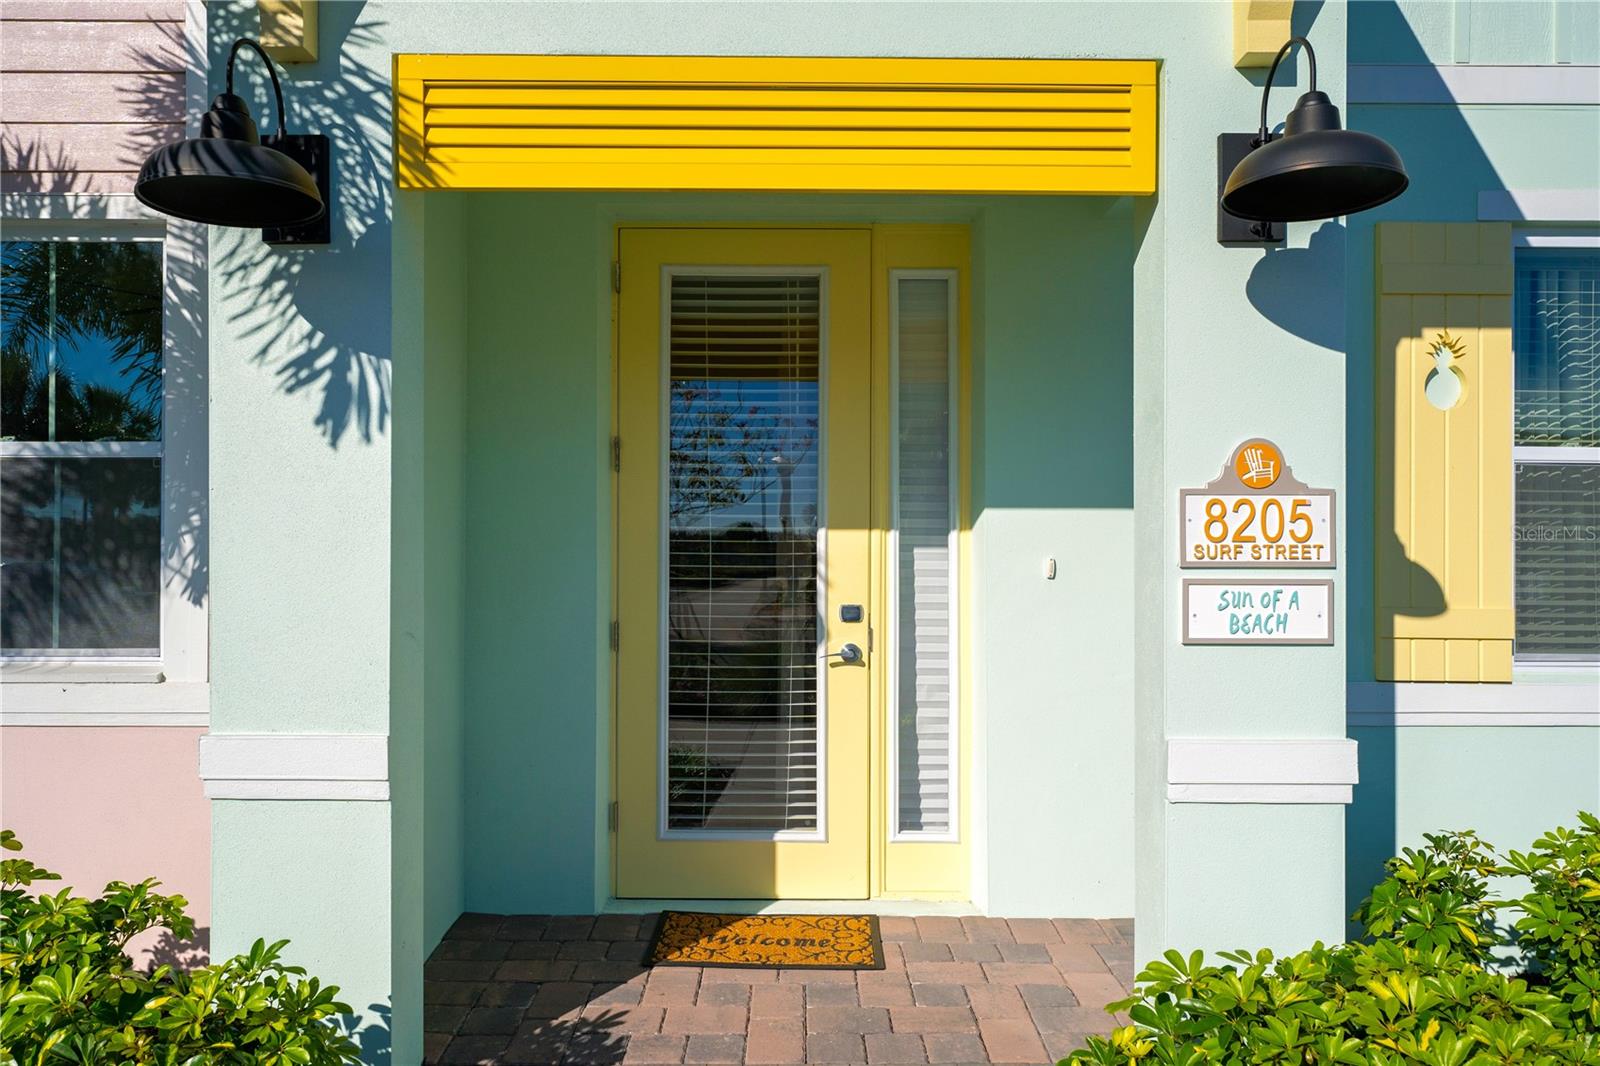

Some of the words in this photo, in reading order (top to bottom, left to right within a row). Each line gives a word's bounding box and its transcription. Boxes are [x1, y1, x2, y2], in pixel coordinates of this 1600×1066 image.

[1204, 498, 1313, 543] 8205
[1193, 544, 1244, 561] SURF
[1250, 544, 1325, 561] STREET
[1288, 590, 1300, 611] A
[1229, 612, 1289, 635] BEACH
[705, 932, 832, 949] Welcome
